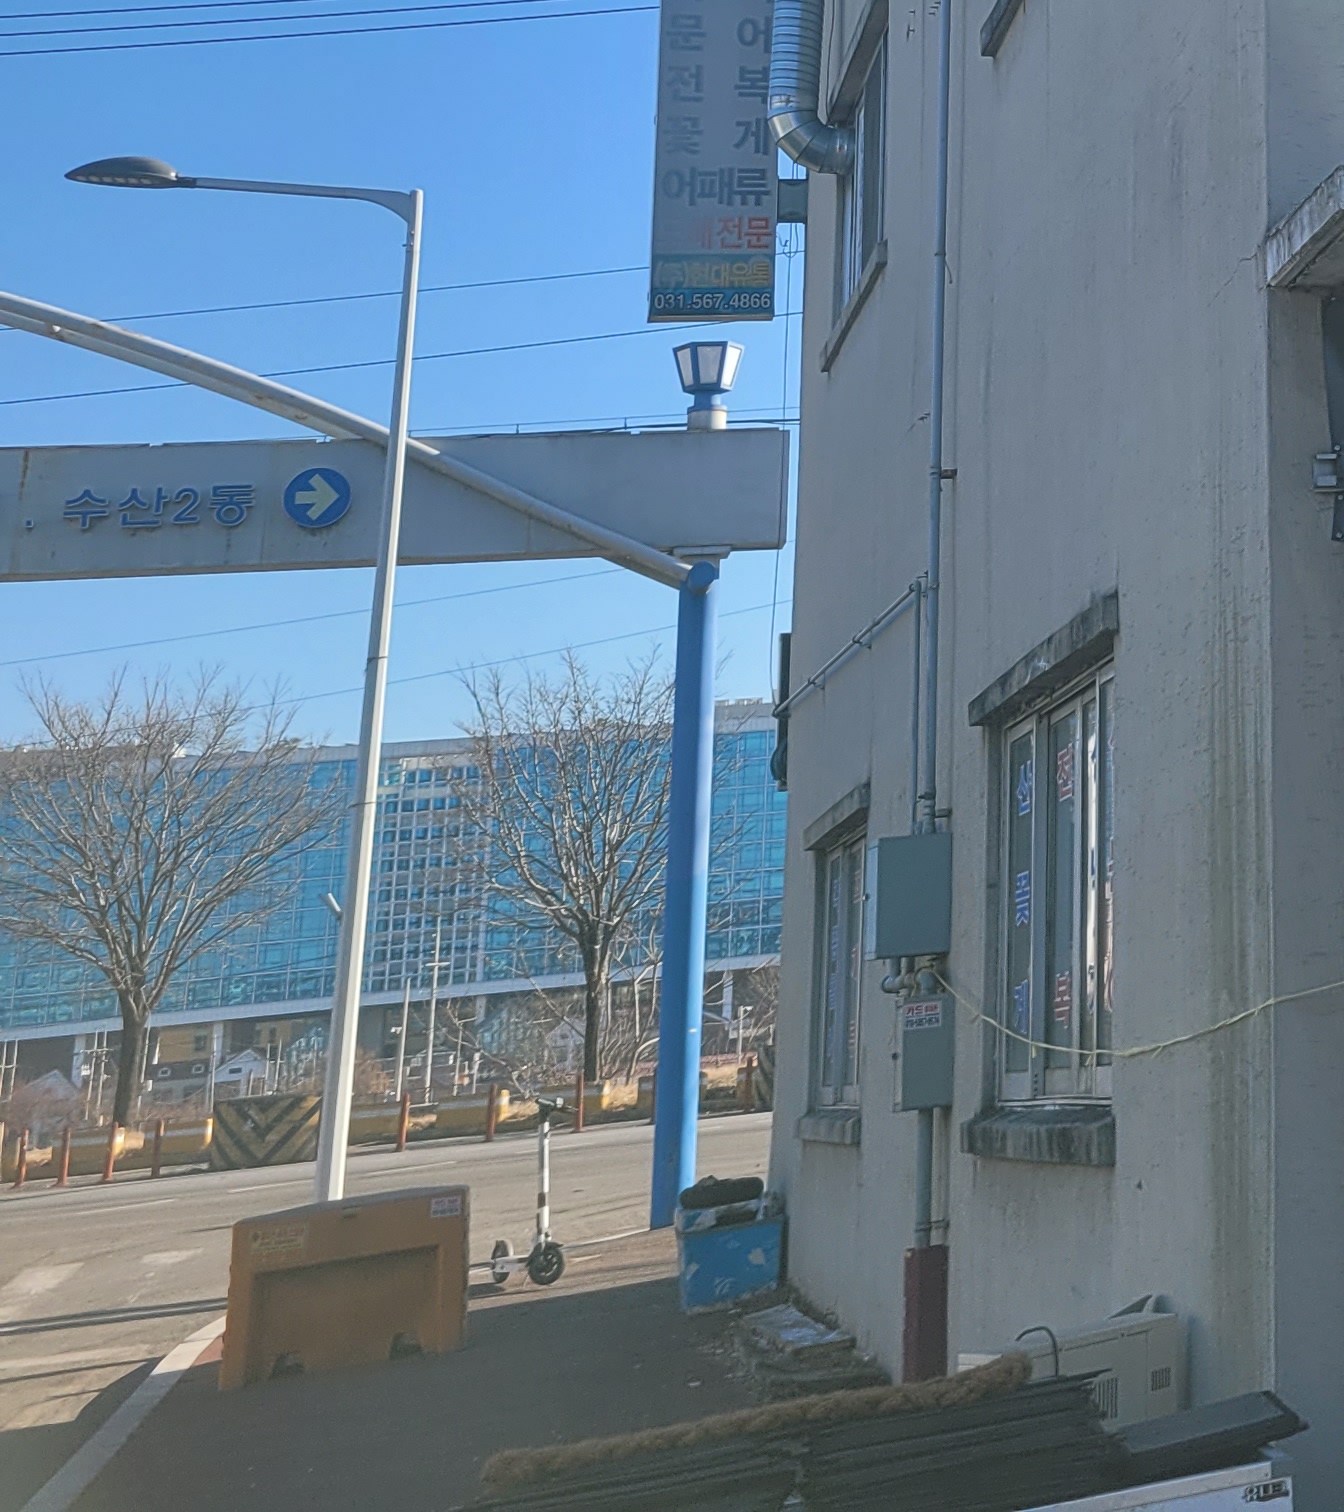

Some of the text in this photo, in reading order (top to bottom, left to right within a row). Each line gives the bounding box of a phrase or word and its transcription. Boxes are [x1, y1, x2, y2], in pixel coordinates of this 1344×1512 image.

[661, 166, 772, 207] 어패류
[654, 293, 771, 309] 031.567.4866
[63, 484, 256, 529] 수산2동
